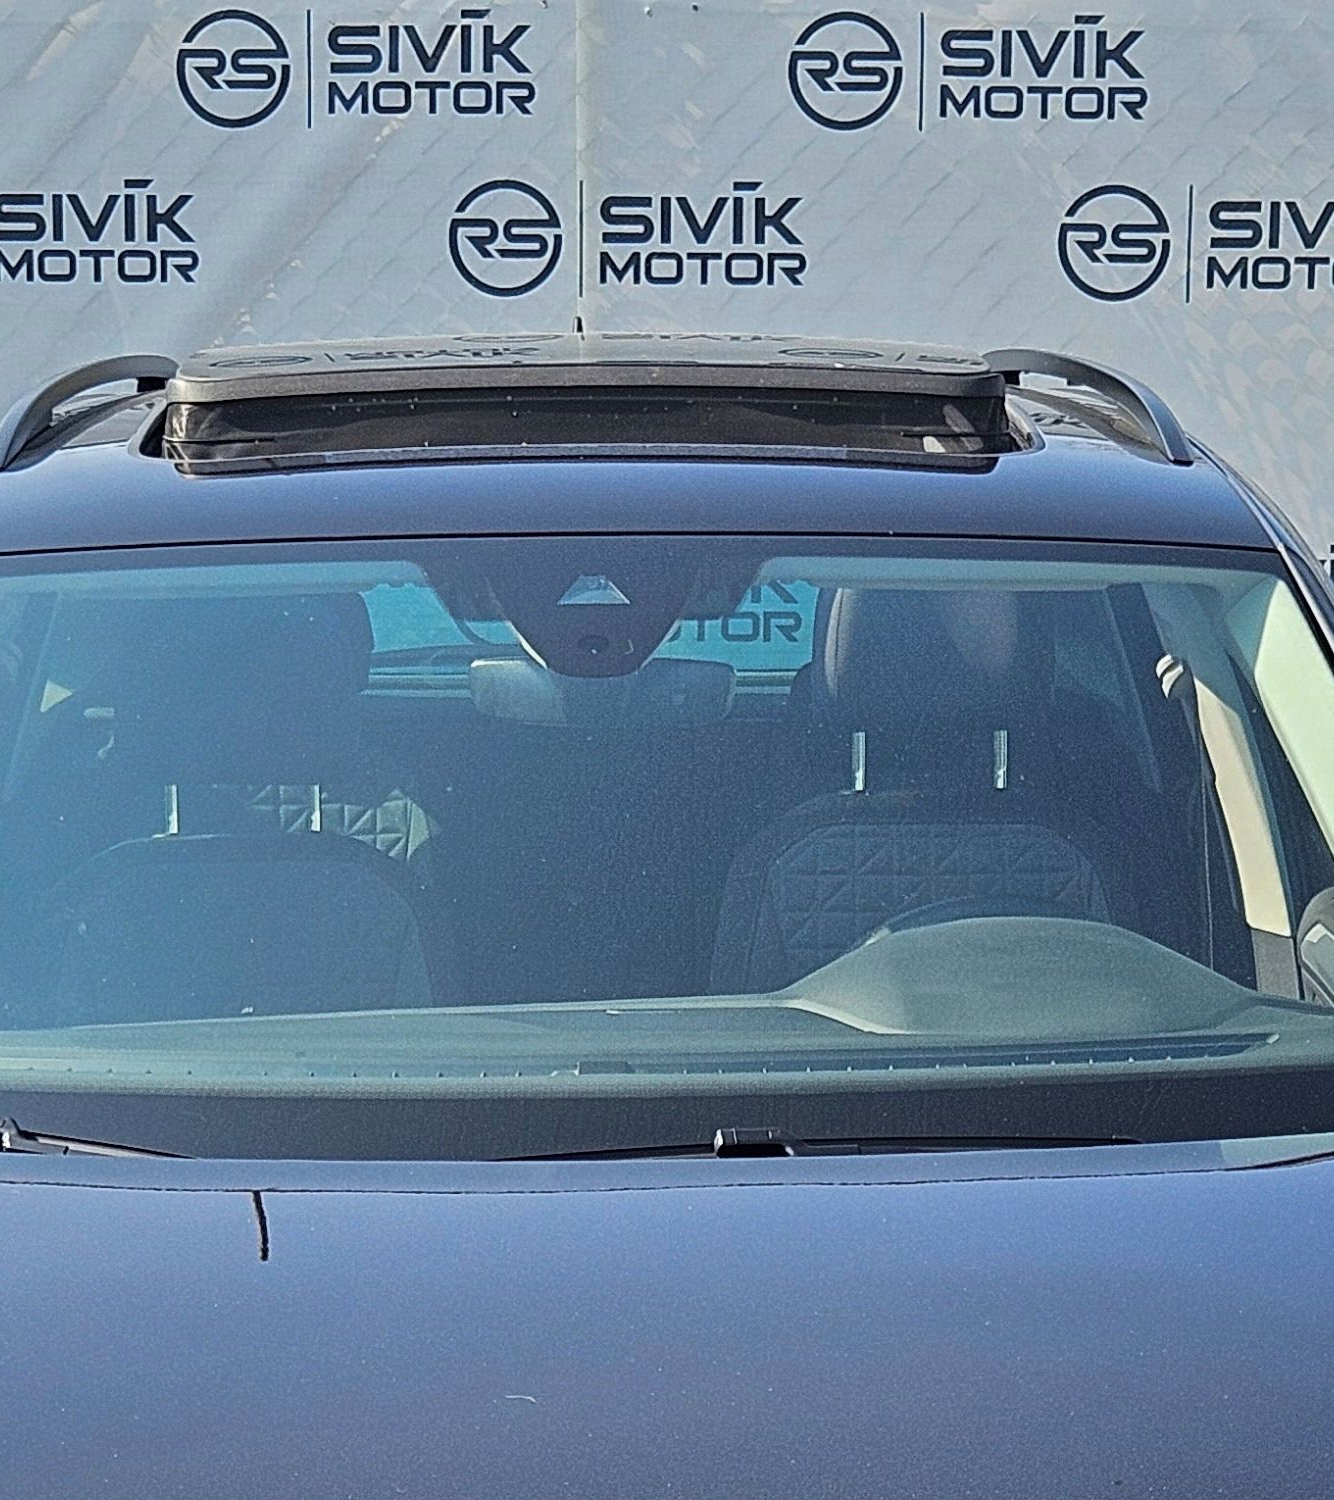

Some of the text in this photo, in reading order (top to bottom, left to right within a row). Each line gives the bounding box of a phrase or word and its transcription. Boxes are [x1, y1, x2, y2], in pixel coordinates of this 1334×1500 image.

[329, 82, 535, 114] MOTOR
[940, 85, 1147, 119] MOTOR
[600, 252, 806, 285] MOTOR
